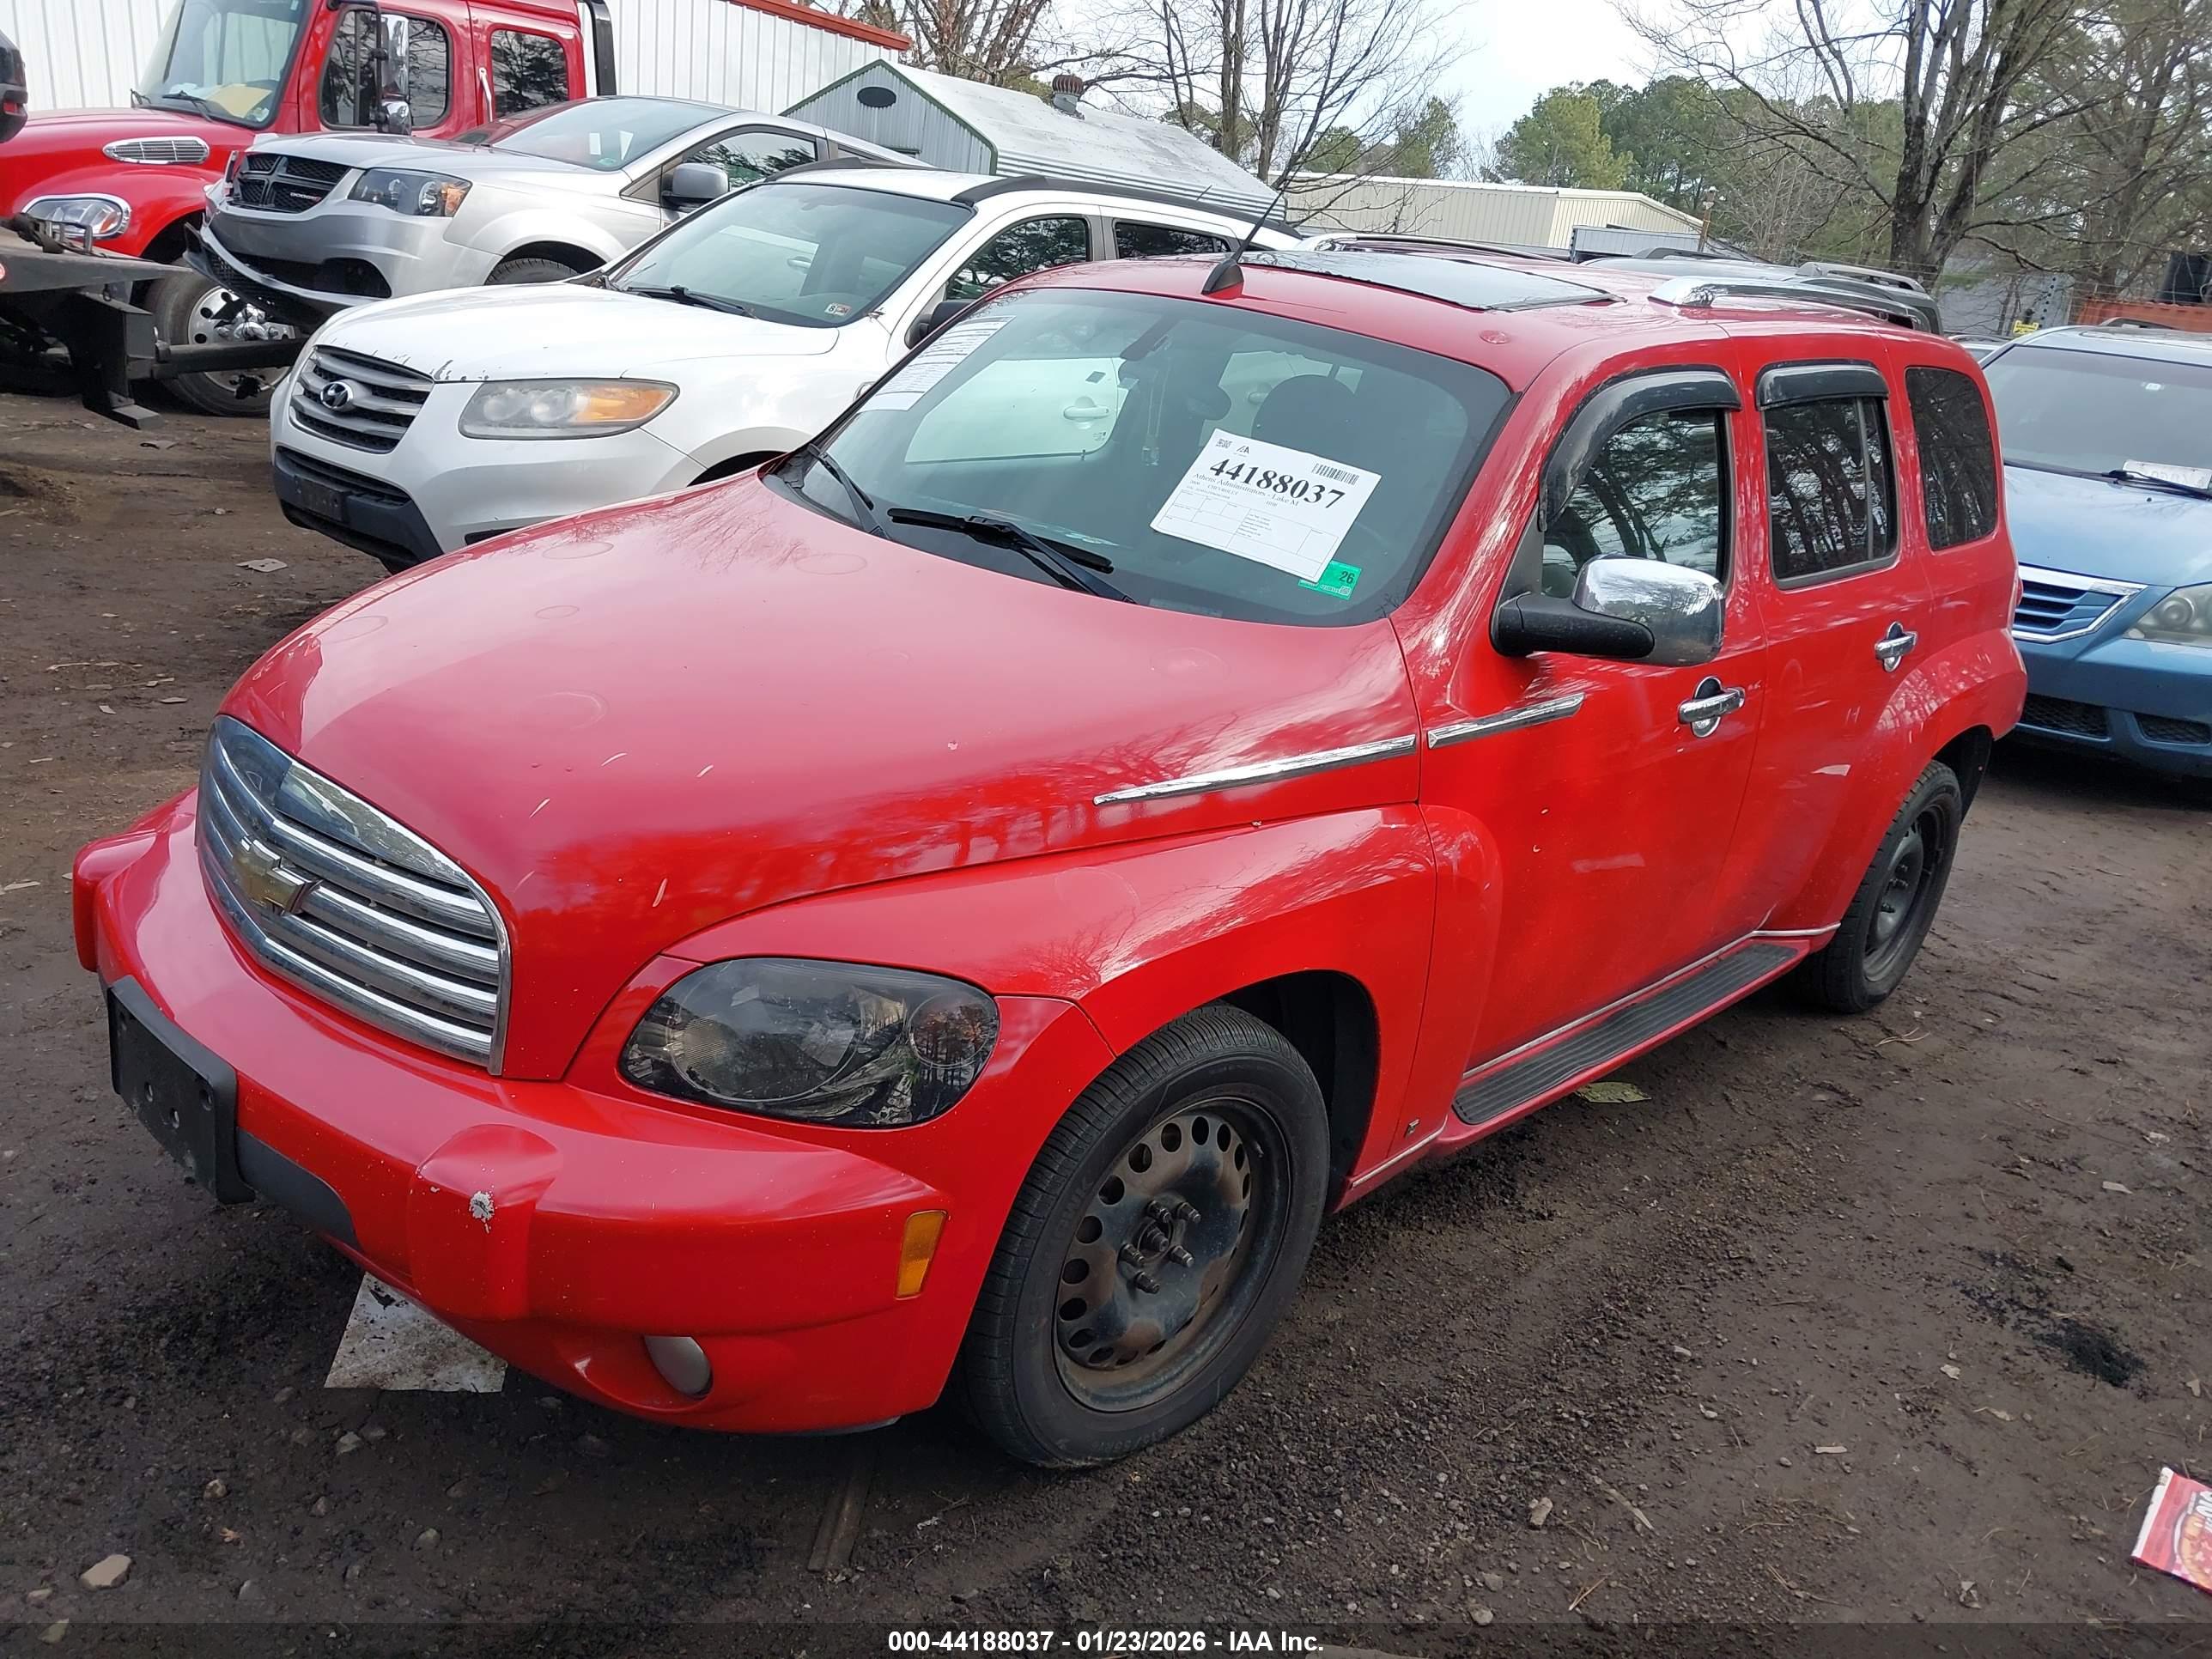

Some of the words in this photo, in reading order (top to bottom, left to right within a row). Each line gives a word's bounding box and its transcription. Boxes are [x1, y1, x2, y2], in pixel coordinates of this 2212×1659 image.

[1209, 459, 1346, 509] 44188037
[1217, 479, 1266, 496] Administrators
[1340, 570, 1356, 584] 26
